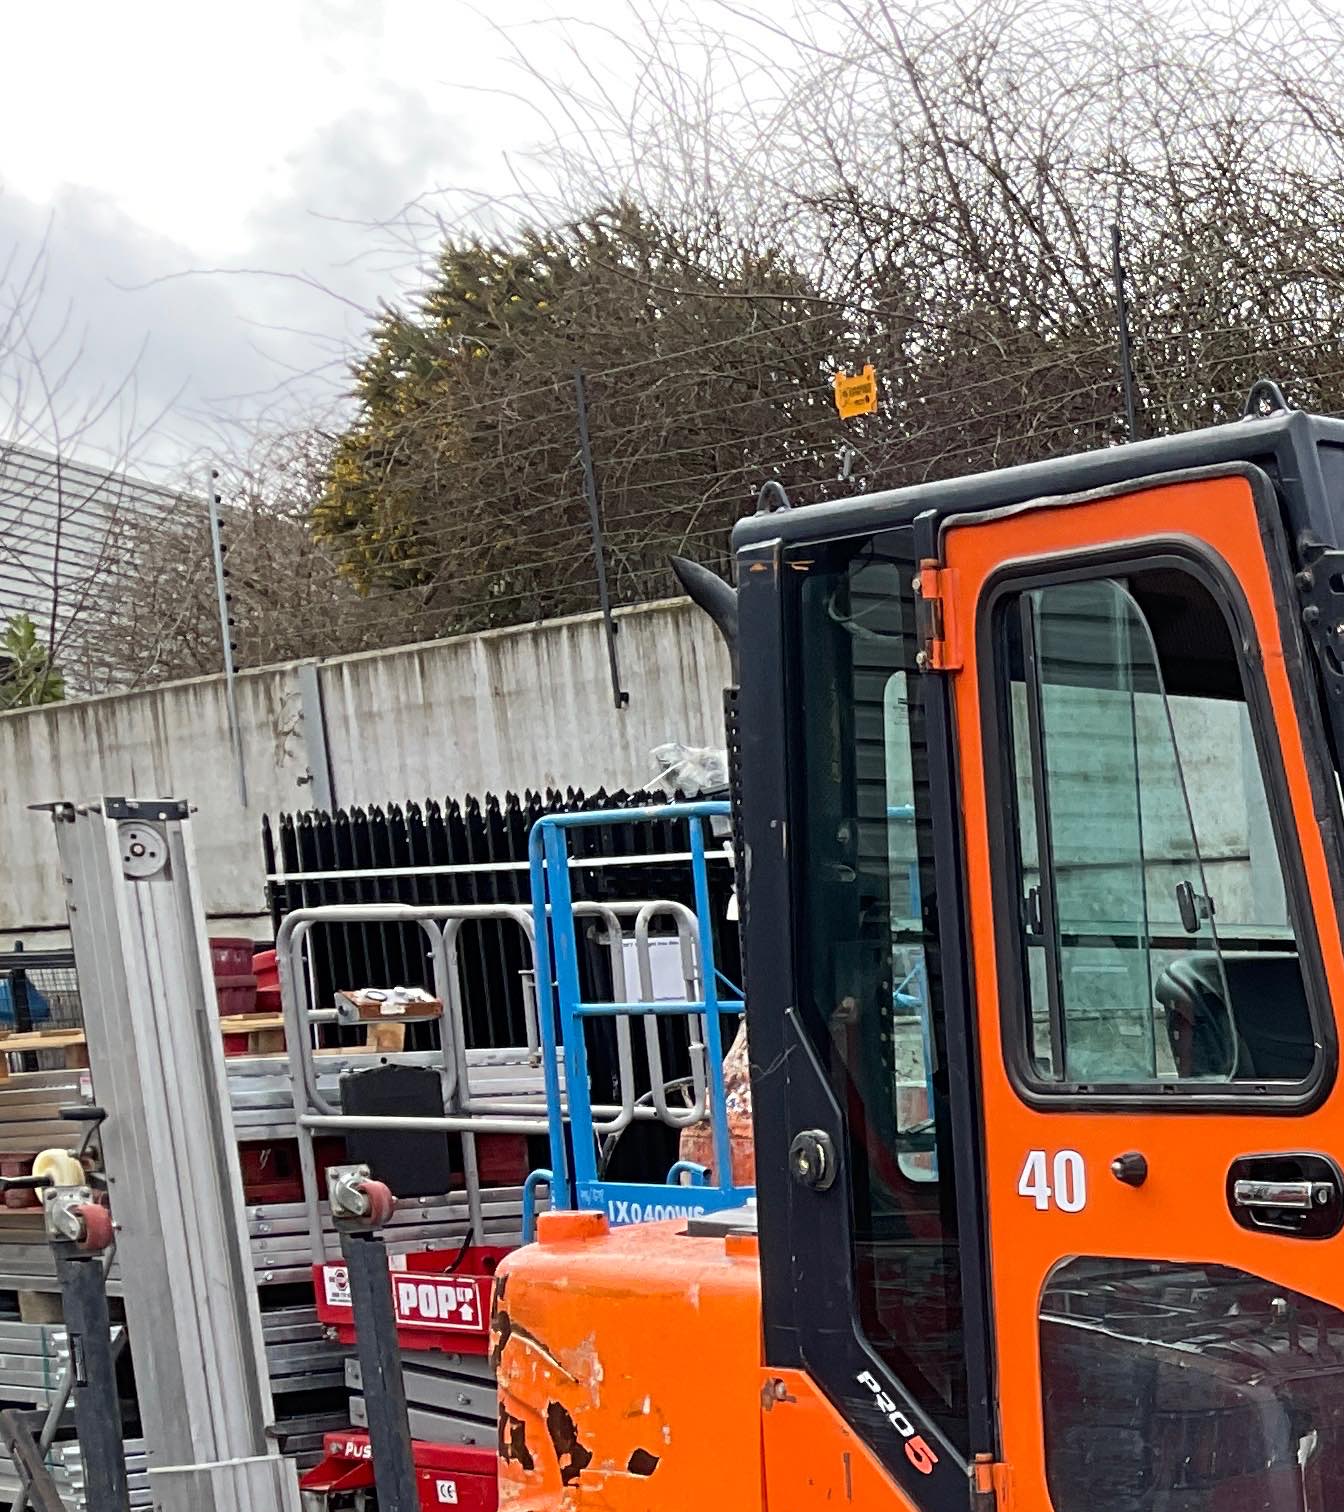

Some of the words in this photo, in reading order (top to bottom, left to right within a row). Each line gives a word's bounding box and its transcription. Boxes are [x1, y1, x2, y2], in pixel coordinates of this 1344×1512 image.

[1018, 1149, 1086, 1213] 40
[398, 1283, 457, 1319] POP
[457, 1287, 473, 1302] UP
[345, 1442, 372, 1459] PUS
